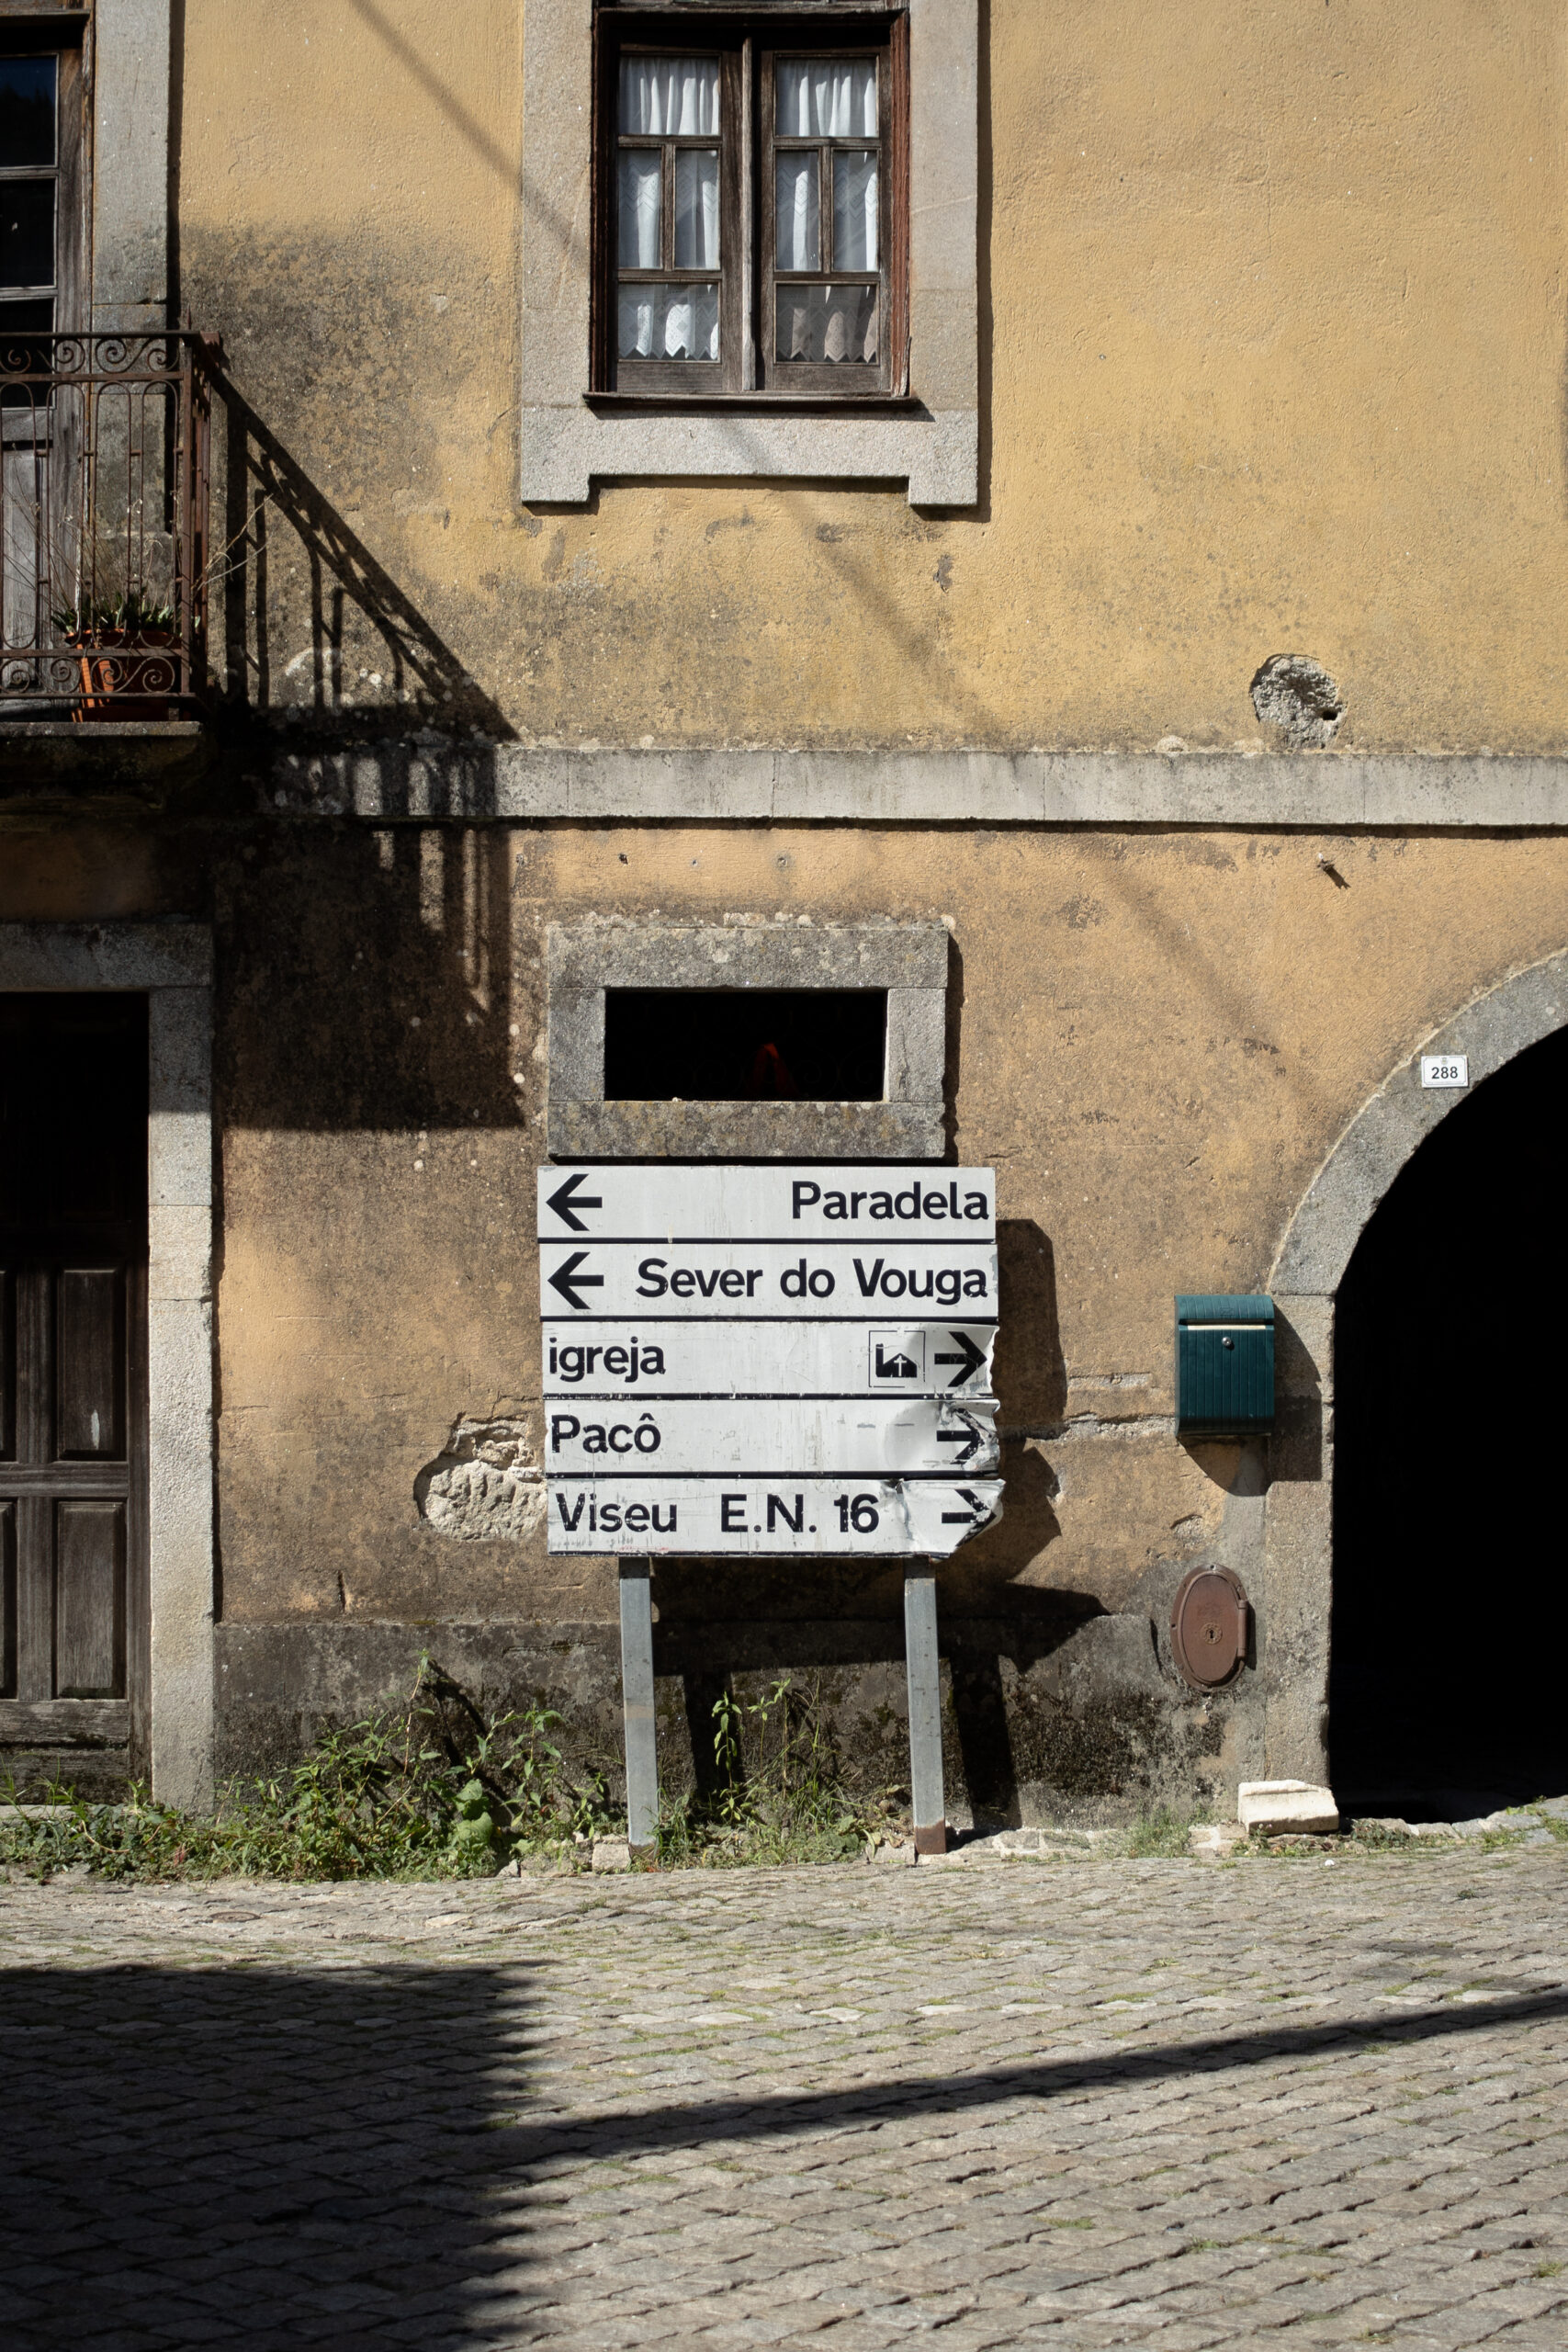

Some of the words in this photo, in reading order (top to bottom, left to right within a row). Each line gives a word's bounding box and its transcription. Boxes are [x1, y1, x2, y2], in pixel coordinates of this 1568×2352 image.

[1431, 1067, 1459, 1080] 288
[792, 1181, 989, 1220] Paradela
[635, 1258, 763, 1298] Sever
[780, 1258, 836, 1298] do
[852, 1258, 988, 1306] Vouga
[549, 1336, 666, 1383] igreja
[551, 1412, 661, 1454] Pacô
[555, 1493, 677, 1533] Viseu
[721, 1493, 818, 1533] E.N.
[833, 1493, 879, 1533] 16
